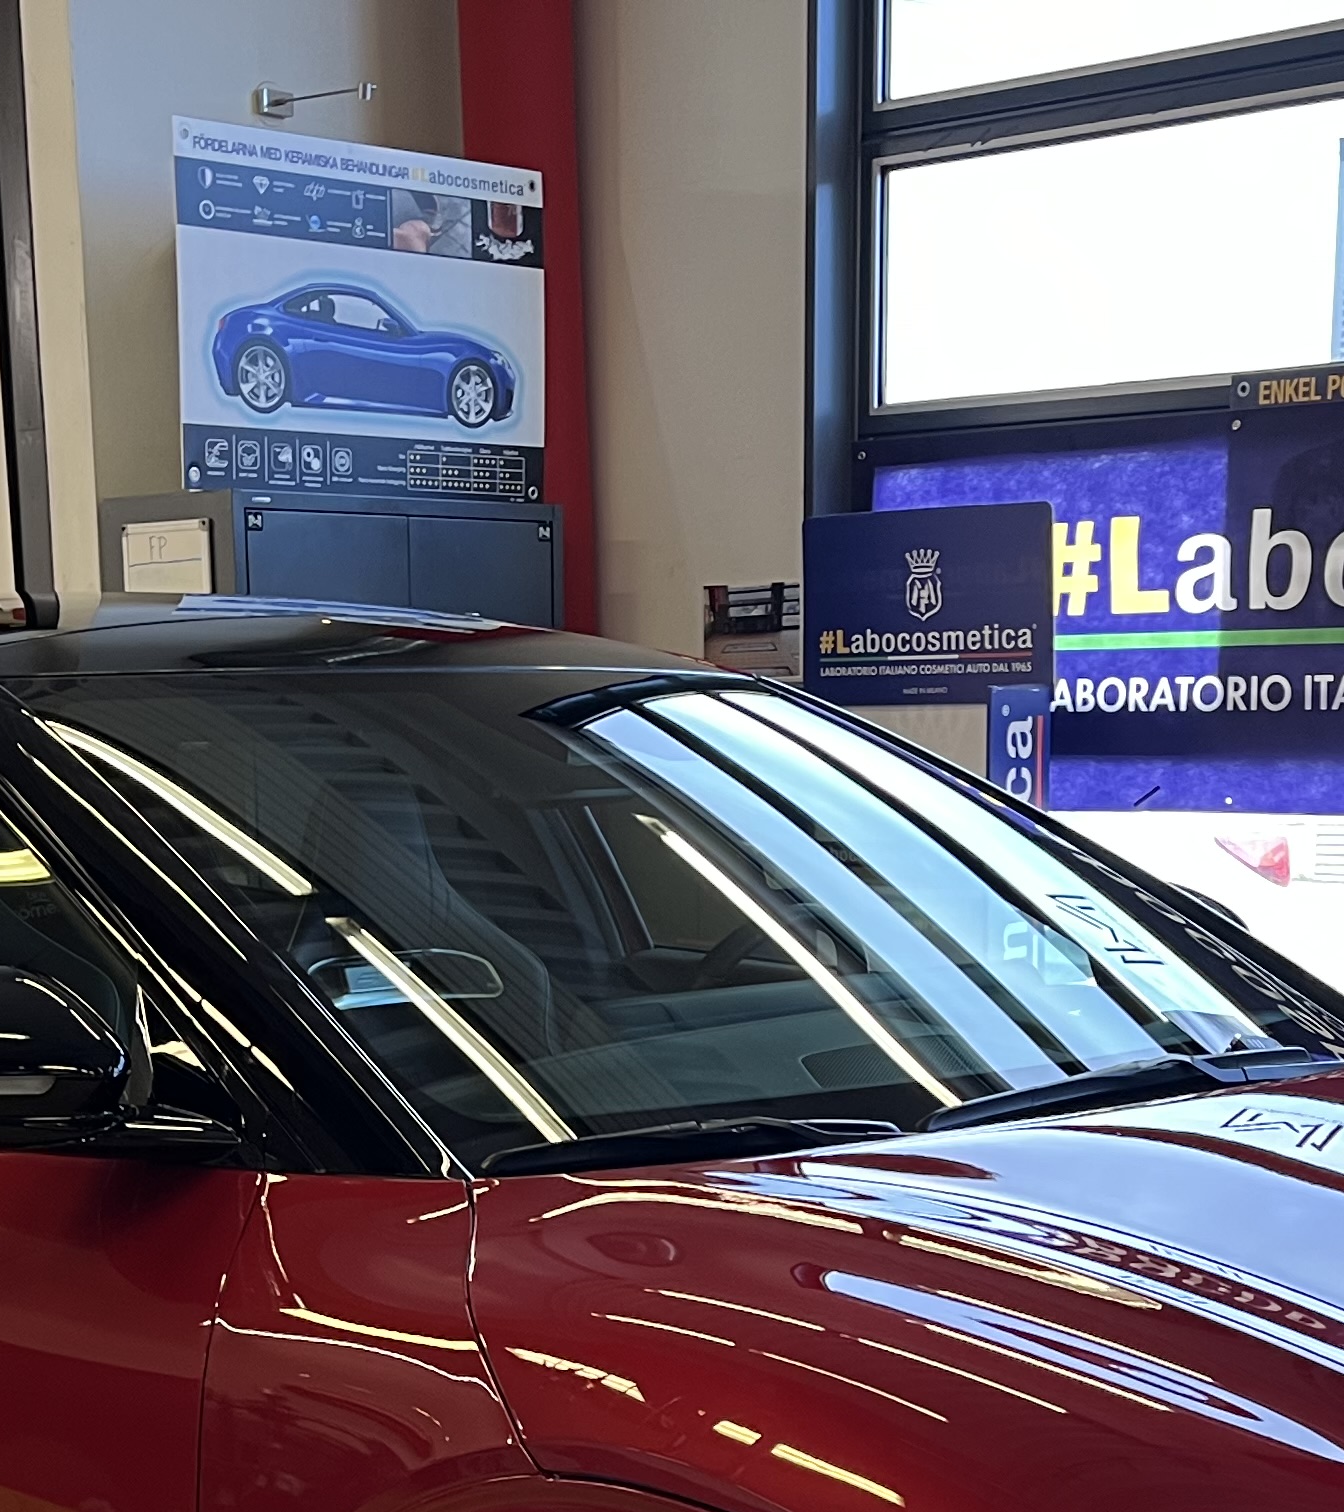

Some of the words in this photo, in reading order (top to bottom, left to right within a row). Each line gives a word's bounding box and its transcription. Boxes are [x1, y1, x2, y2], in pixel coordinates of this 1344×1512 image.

[260, 145, 282, 162] MED
[1258, 375, 1322, 405] ENKEL
[820, 665, 878, 677] LABORATORIO
[879, 664, 918, 676] ITALIANO
[919, 663, 965, 675] COSMETICI
[966, 662, 991, 674] AUTO
[992, 661, 1010, 673] DAL
[1011, 660, 1032, 673] 1965
[1050, 673, 1292, 713] ABORATORIO
